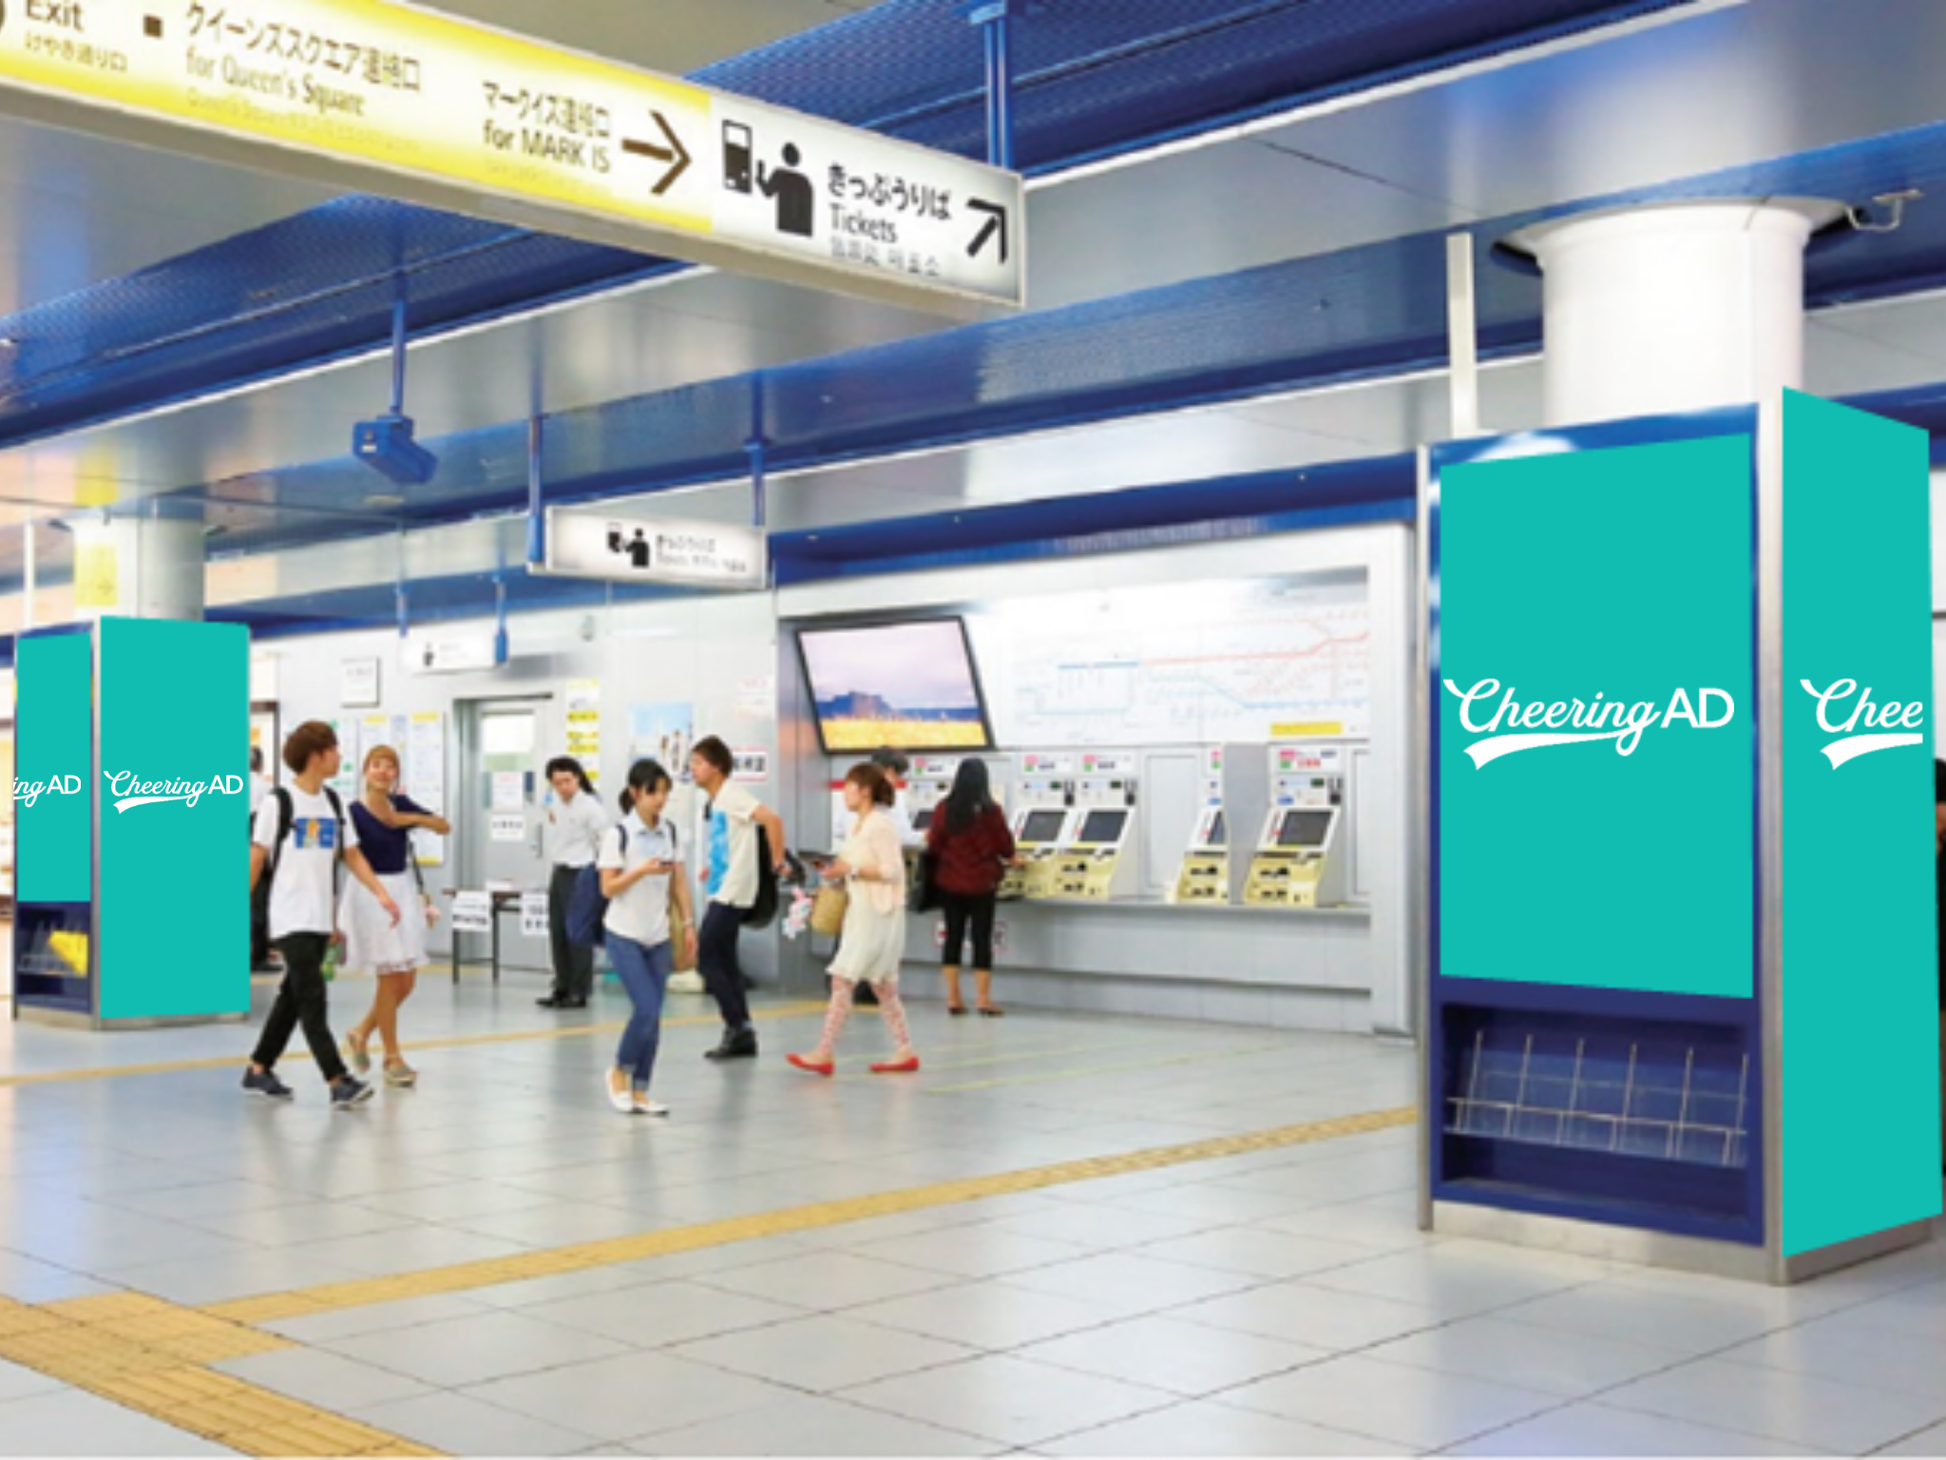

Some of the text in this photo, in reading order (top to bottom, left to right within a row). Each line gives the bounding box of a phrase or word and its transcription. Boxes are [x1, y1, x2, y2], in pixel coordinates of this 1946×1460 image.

[26, 0, 83, 32] Exit
[187, 46, 216, 79] for
[302, 73, 365, 116] Square
[484, 118, 514, 150] for
[521, 126, 585, 167] MARK
[591, 143, 611, 174] IS
[828, 161, 952, 220] きっぷうりば
[829, 201, 897, 243] Tickets
[1443, 679, 1735, 757] Cheering AD
[46, 775, 82, 794] AD
[103, 770, 244, 808] Cheering AD
